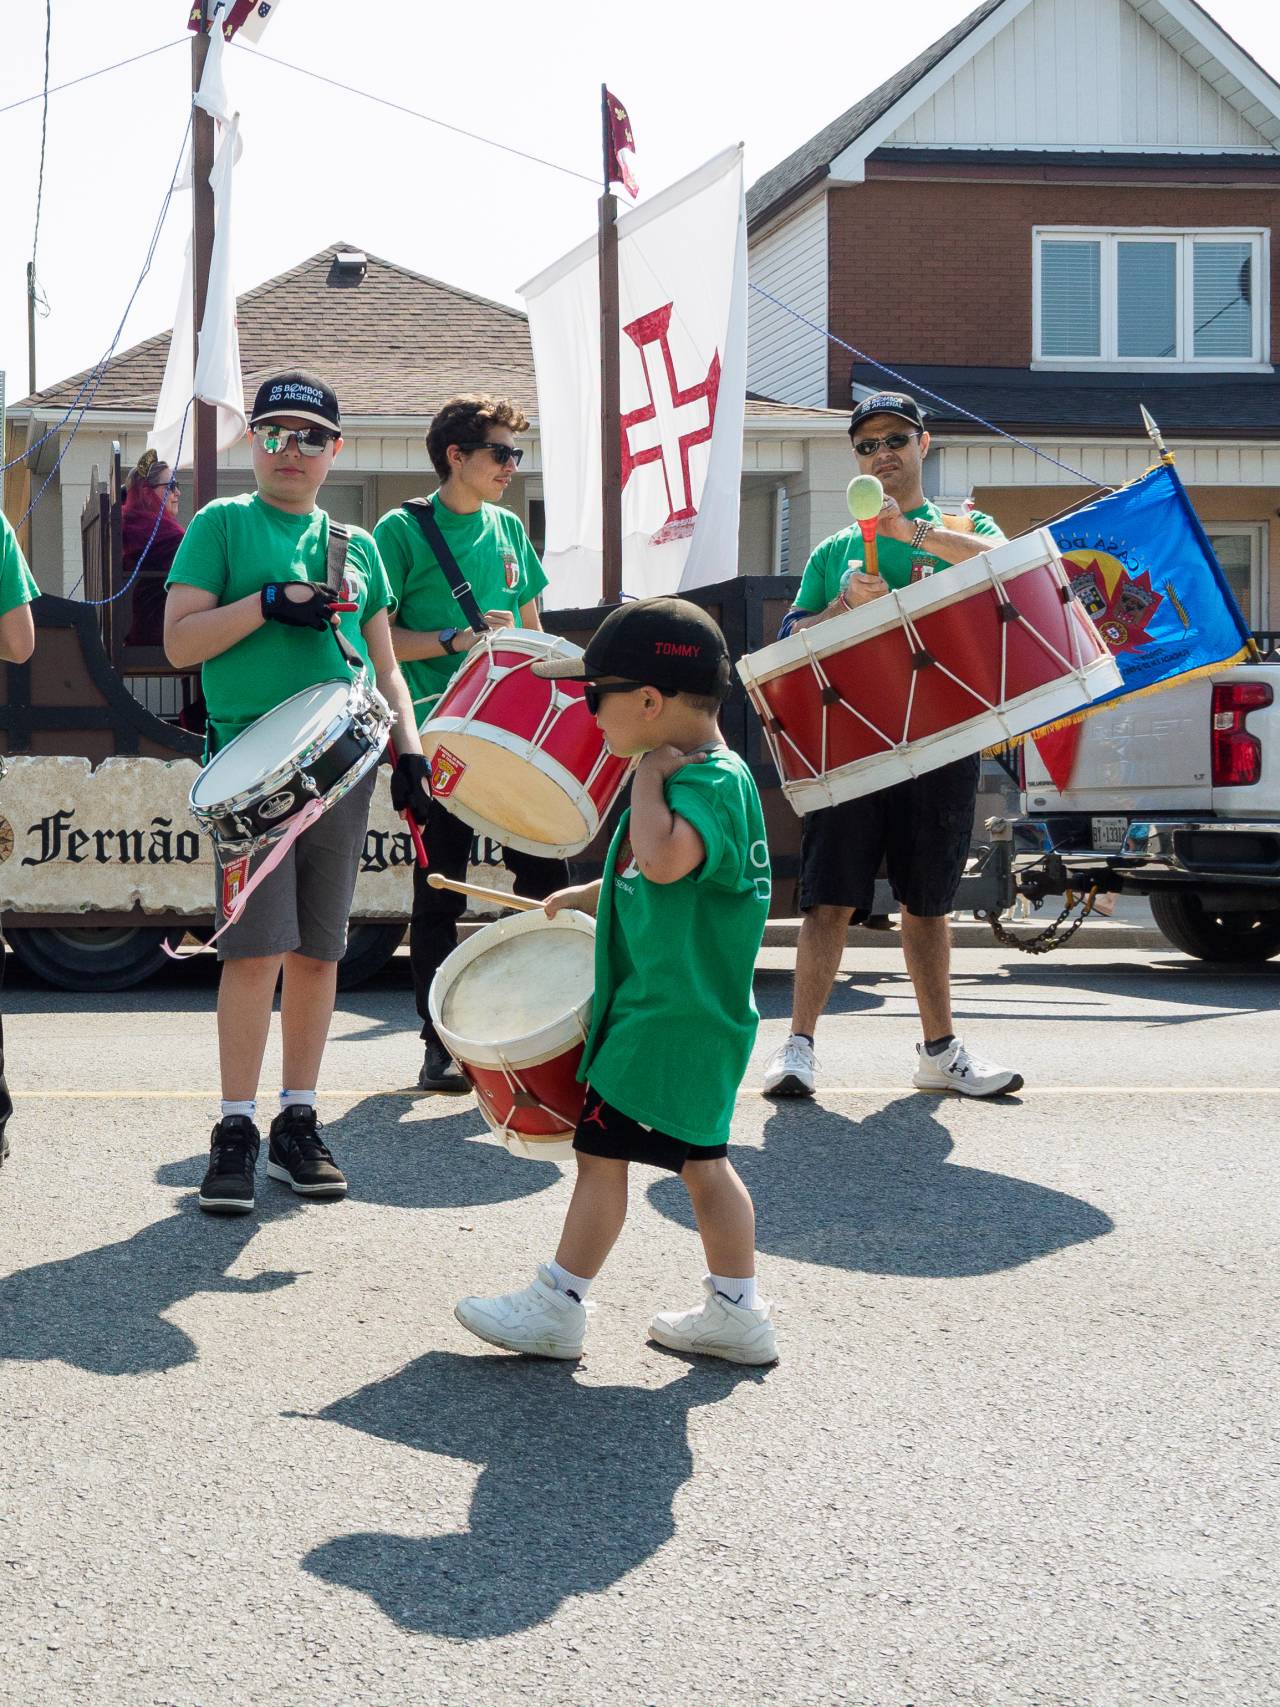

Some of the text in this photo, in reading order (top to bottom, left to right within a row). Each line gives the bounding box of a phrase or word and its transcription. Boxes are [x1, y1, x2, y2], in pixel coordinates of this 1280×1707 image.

[271, 385, 282, 394] OS
[269, 393, 323, 406] DO ARSENAL
[655, 642, 701, 657] TOMMY
[21, 808, 200, 866] Fernão
